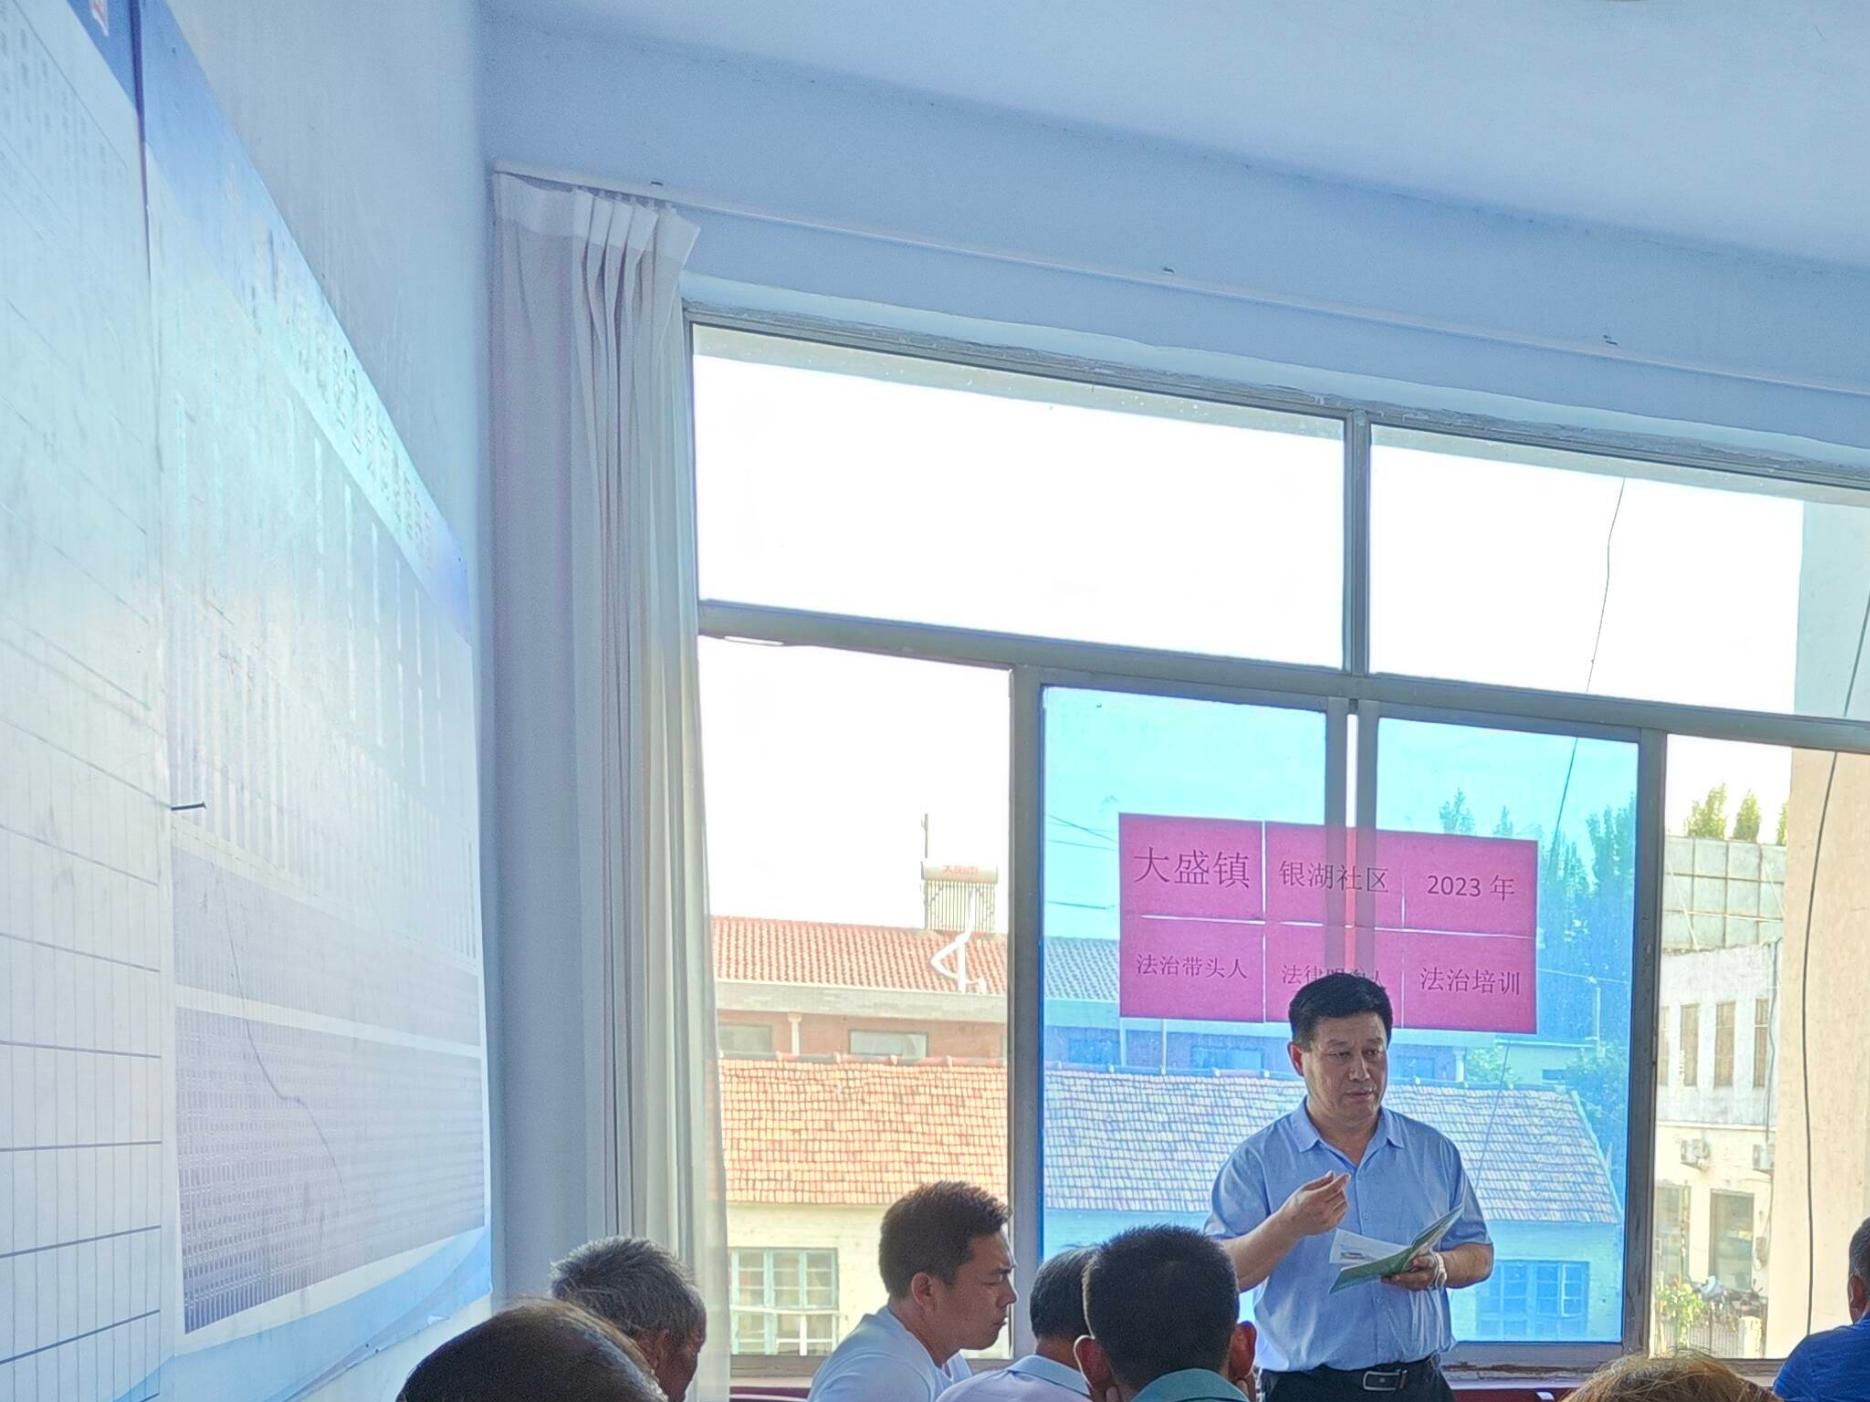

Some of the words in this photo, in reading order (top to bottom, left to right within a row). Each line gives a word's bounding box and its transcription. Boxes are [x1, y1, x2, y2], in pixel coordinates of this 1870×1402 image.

[1133, 845, 1251, 890] 大盛镇
[1278, 859, 1390, 894] 银湖社区
[1427, 874, 1482, 898] 2023
[1490, 874, 1516, 903] 年
[1136, 953, 1249, 981] 法治带头人
[1282, 963, 1384, 987] 法律人
[1419, 966, 1521, 997] 法治培训
